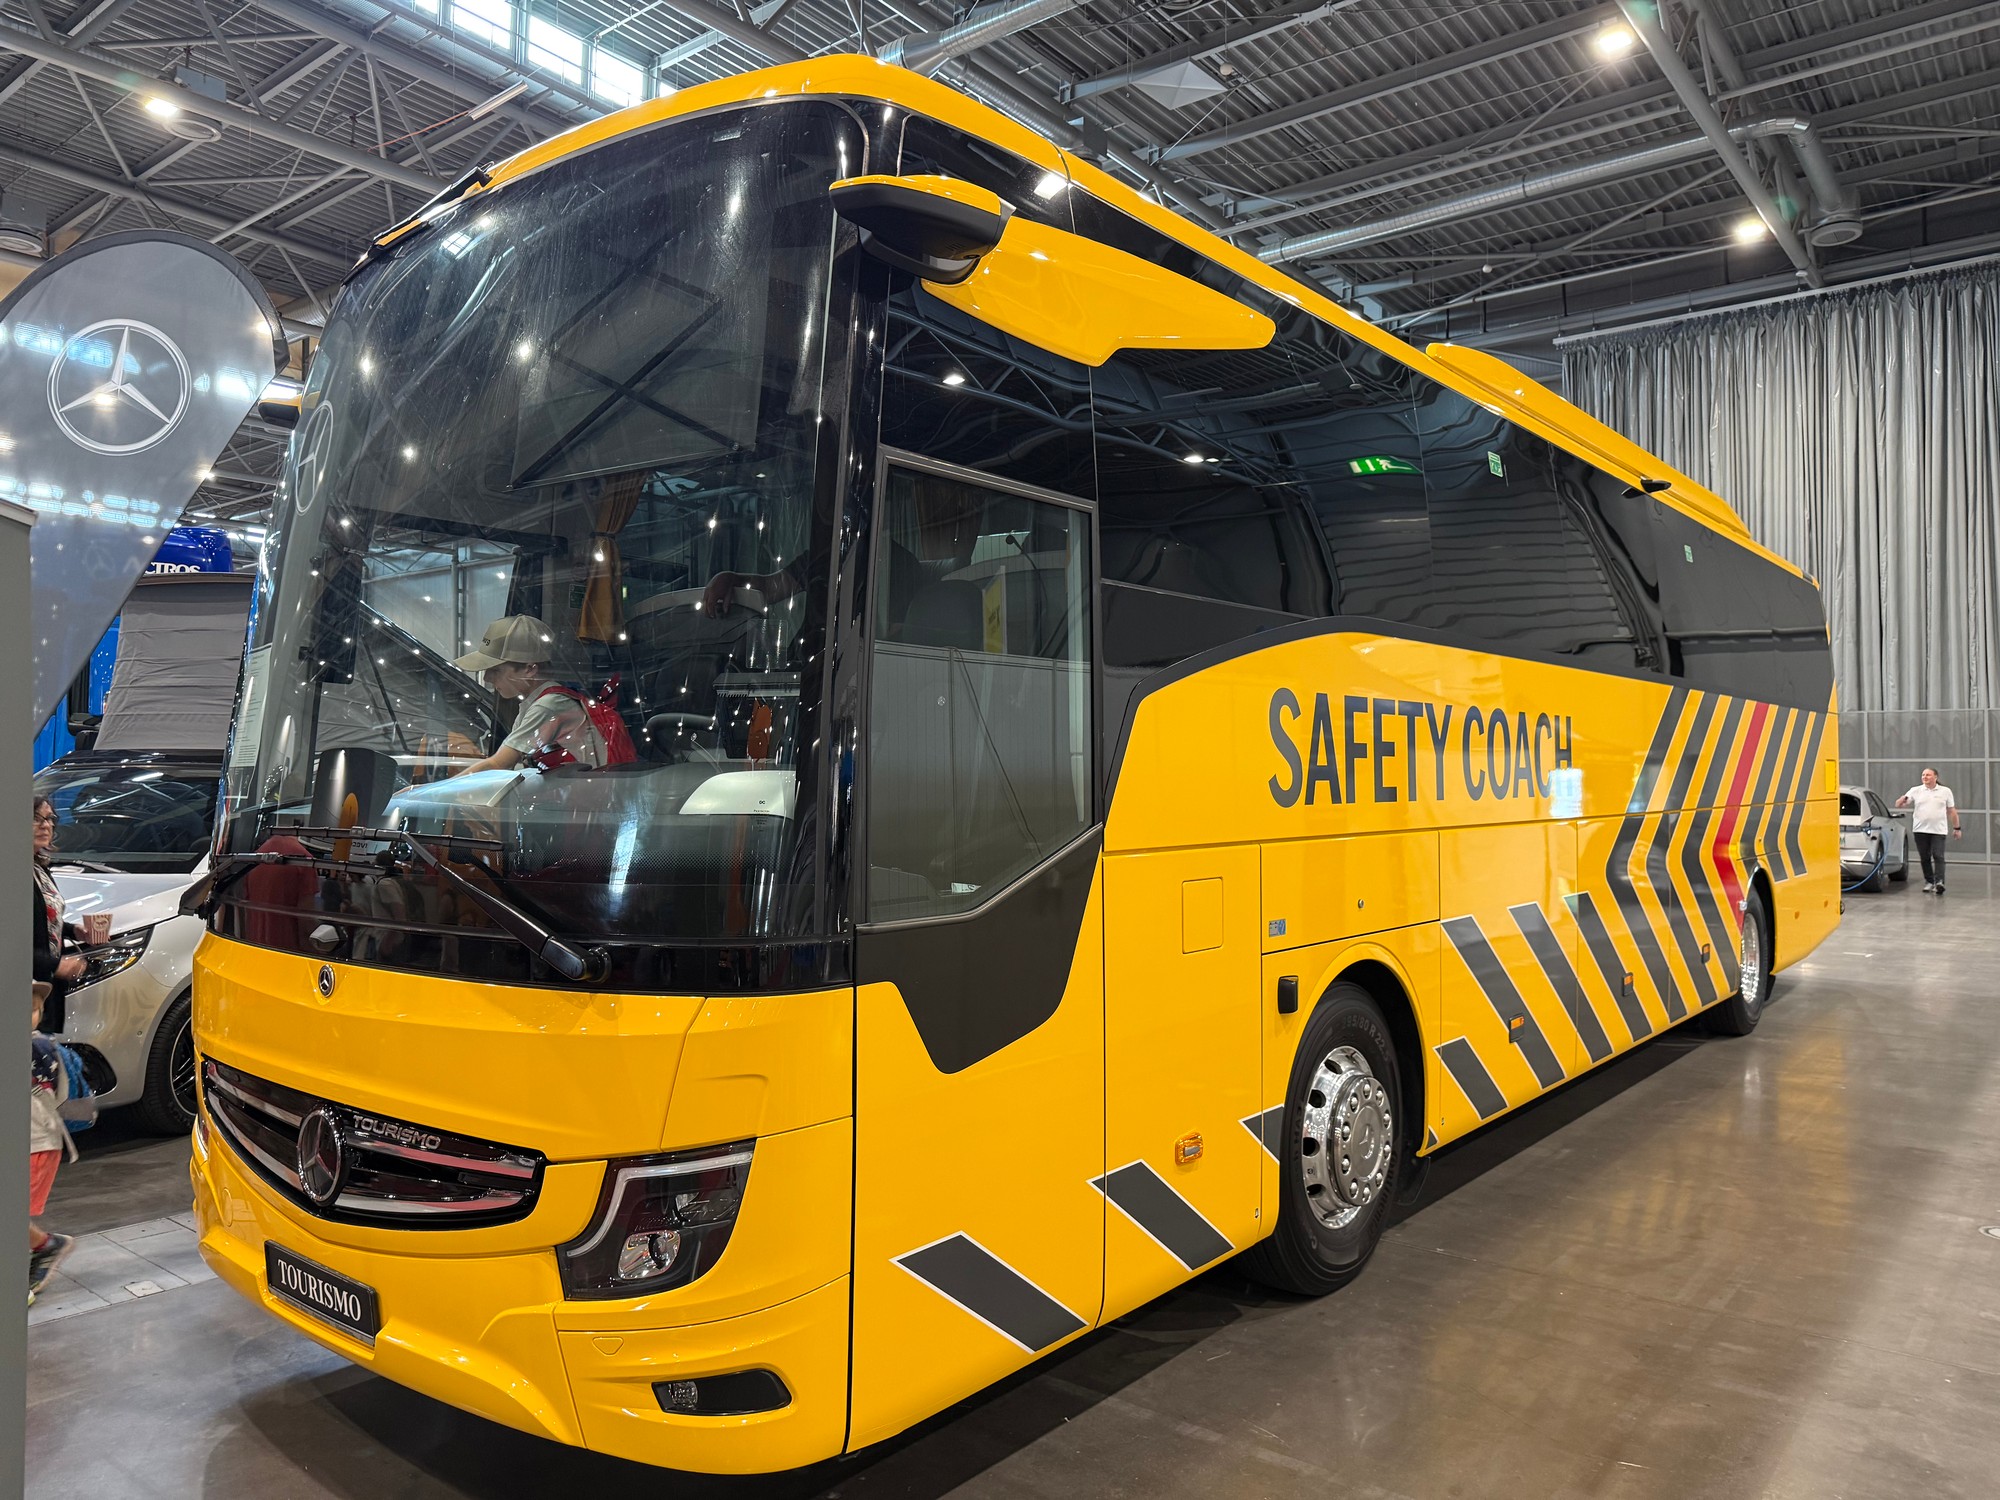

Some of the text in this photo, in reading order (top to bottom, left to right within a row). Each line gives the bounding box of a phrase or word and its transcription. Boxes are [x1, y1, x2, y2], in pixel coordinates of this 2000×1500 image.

[141, 562, 200, 574] CTROS
[1268, 687, 1572, 808] SAFETY COACH
[353, 1114, 441, 1150] TOURISMO
[278, 1259, 361, 1322] TOURISMO
